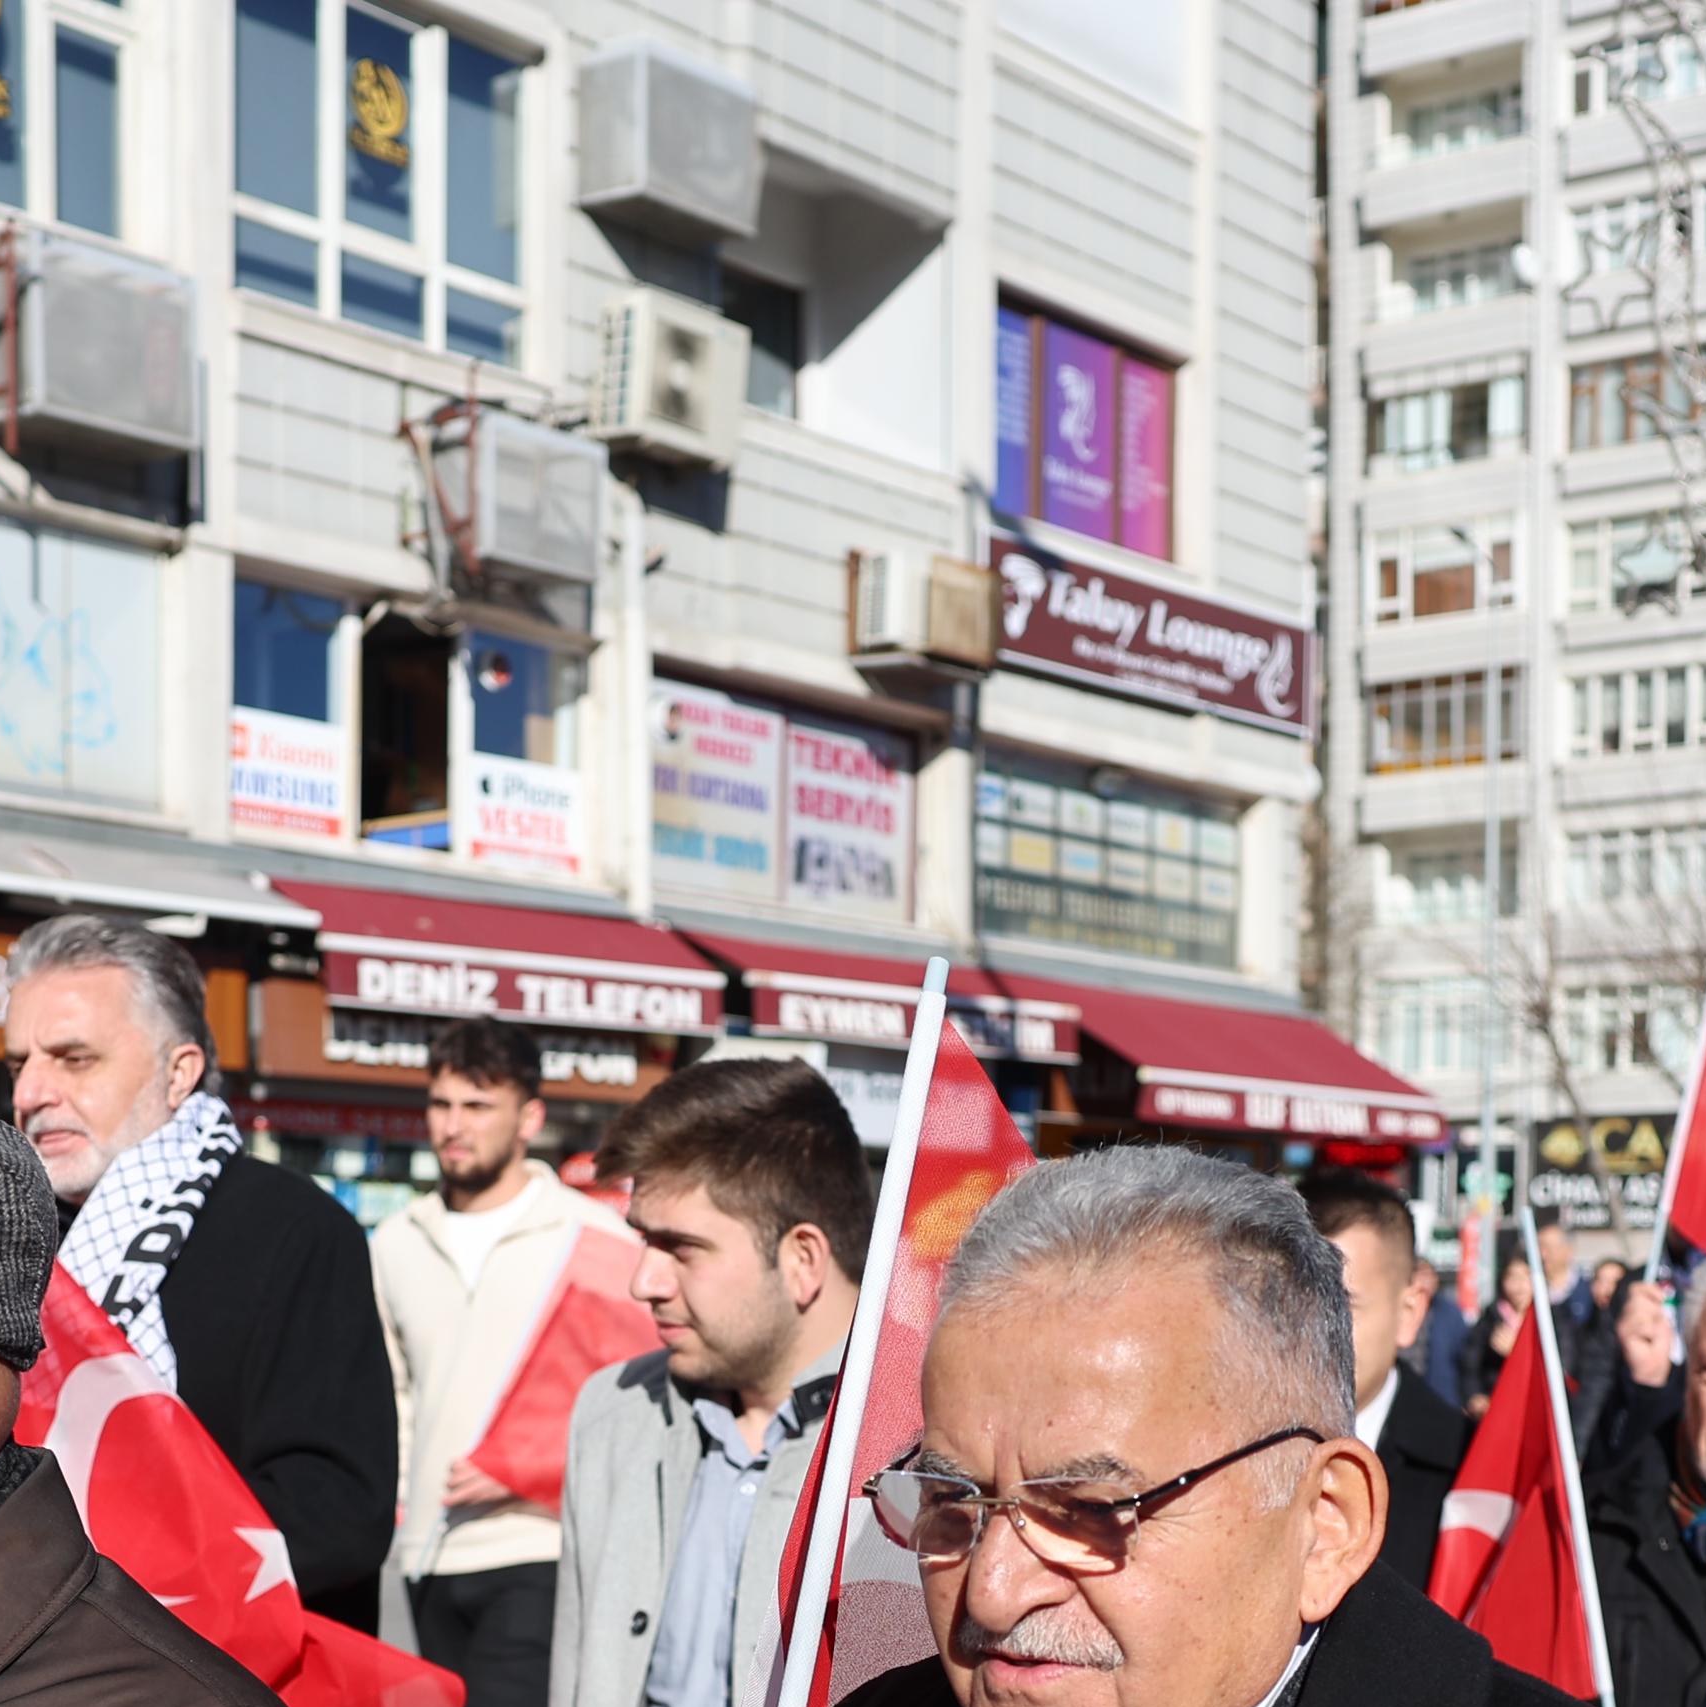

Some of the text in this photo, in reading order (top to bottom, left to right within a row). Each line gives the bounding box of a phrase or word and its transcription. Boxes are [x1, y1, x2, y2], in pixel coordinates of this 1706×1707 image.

[1146, 599, 1271, 681] Lounge
[258, 730, 336, 771] Xiaomi
[501, 774, 572, 810] iPhone
[356, 957, 704, 1027] DENİZ TELEFON
